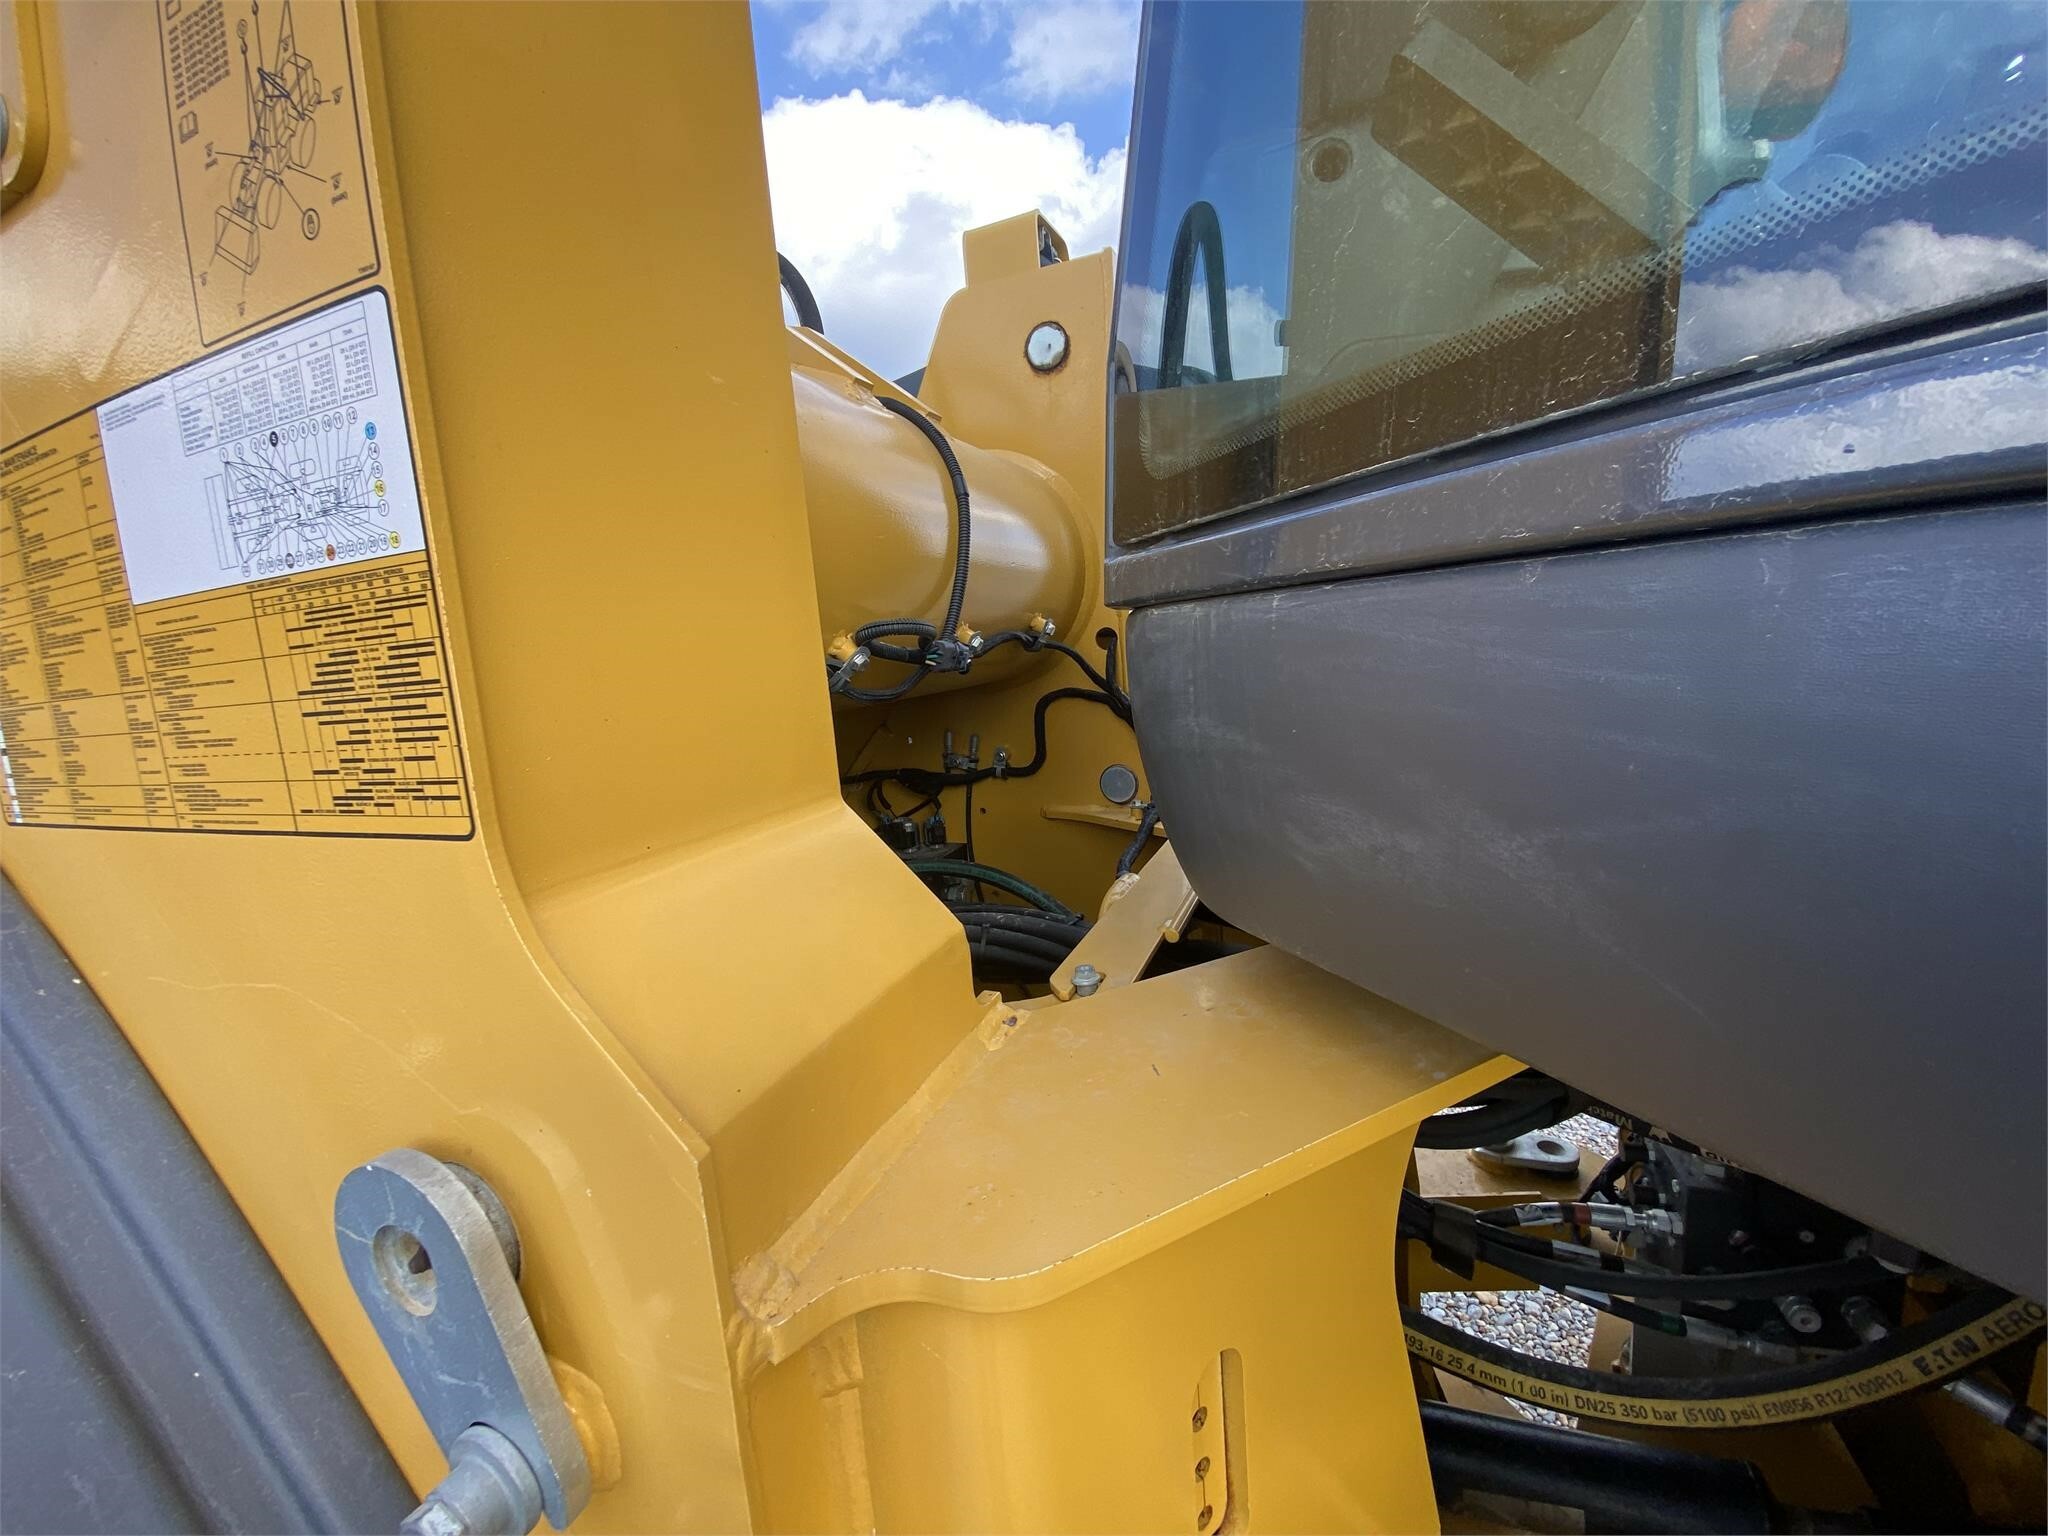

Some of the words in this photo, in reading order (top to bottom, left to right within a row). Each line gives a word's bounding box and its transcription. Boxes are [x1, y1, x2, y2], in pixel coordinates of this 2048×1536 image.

[1447, 1353, 1476, 1375] 25.4
[1479, 1369, 1508, 1388] mm
[1511, 1377, 1546, 1401] (1.00
[1551, 1391, 1569, 1407] in)
[1574, 1394, 1616, 1416] DN25
[1621, 1404, 1649, 1420] 350
[1652, 1407, 1678, 1423] bar
[1682, 1406, 1726, 1424] (5100
[1731, 1403, 1760, 1425] psi)
[1762, 1396, 1815, 1418] EN856
